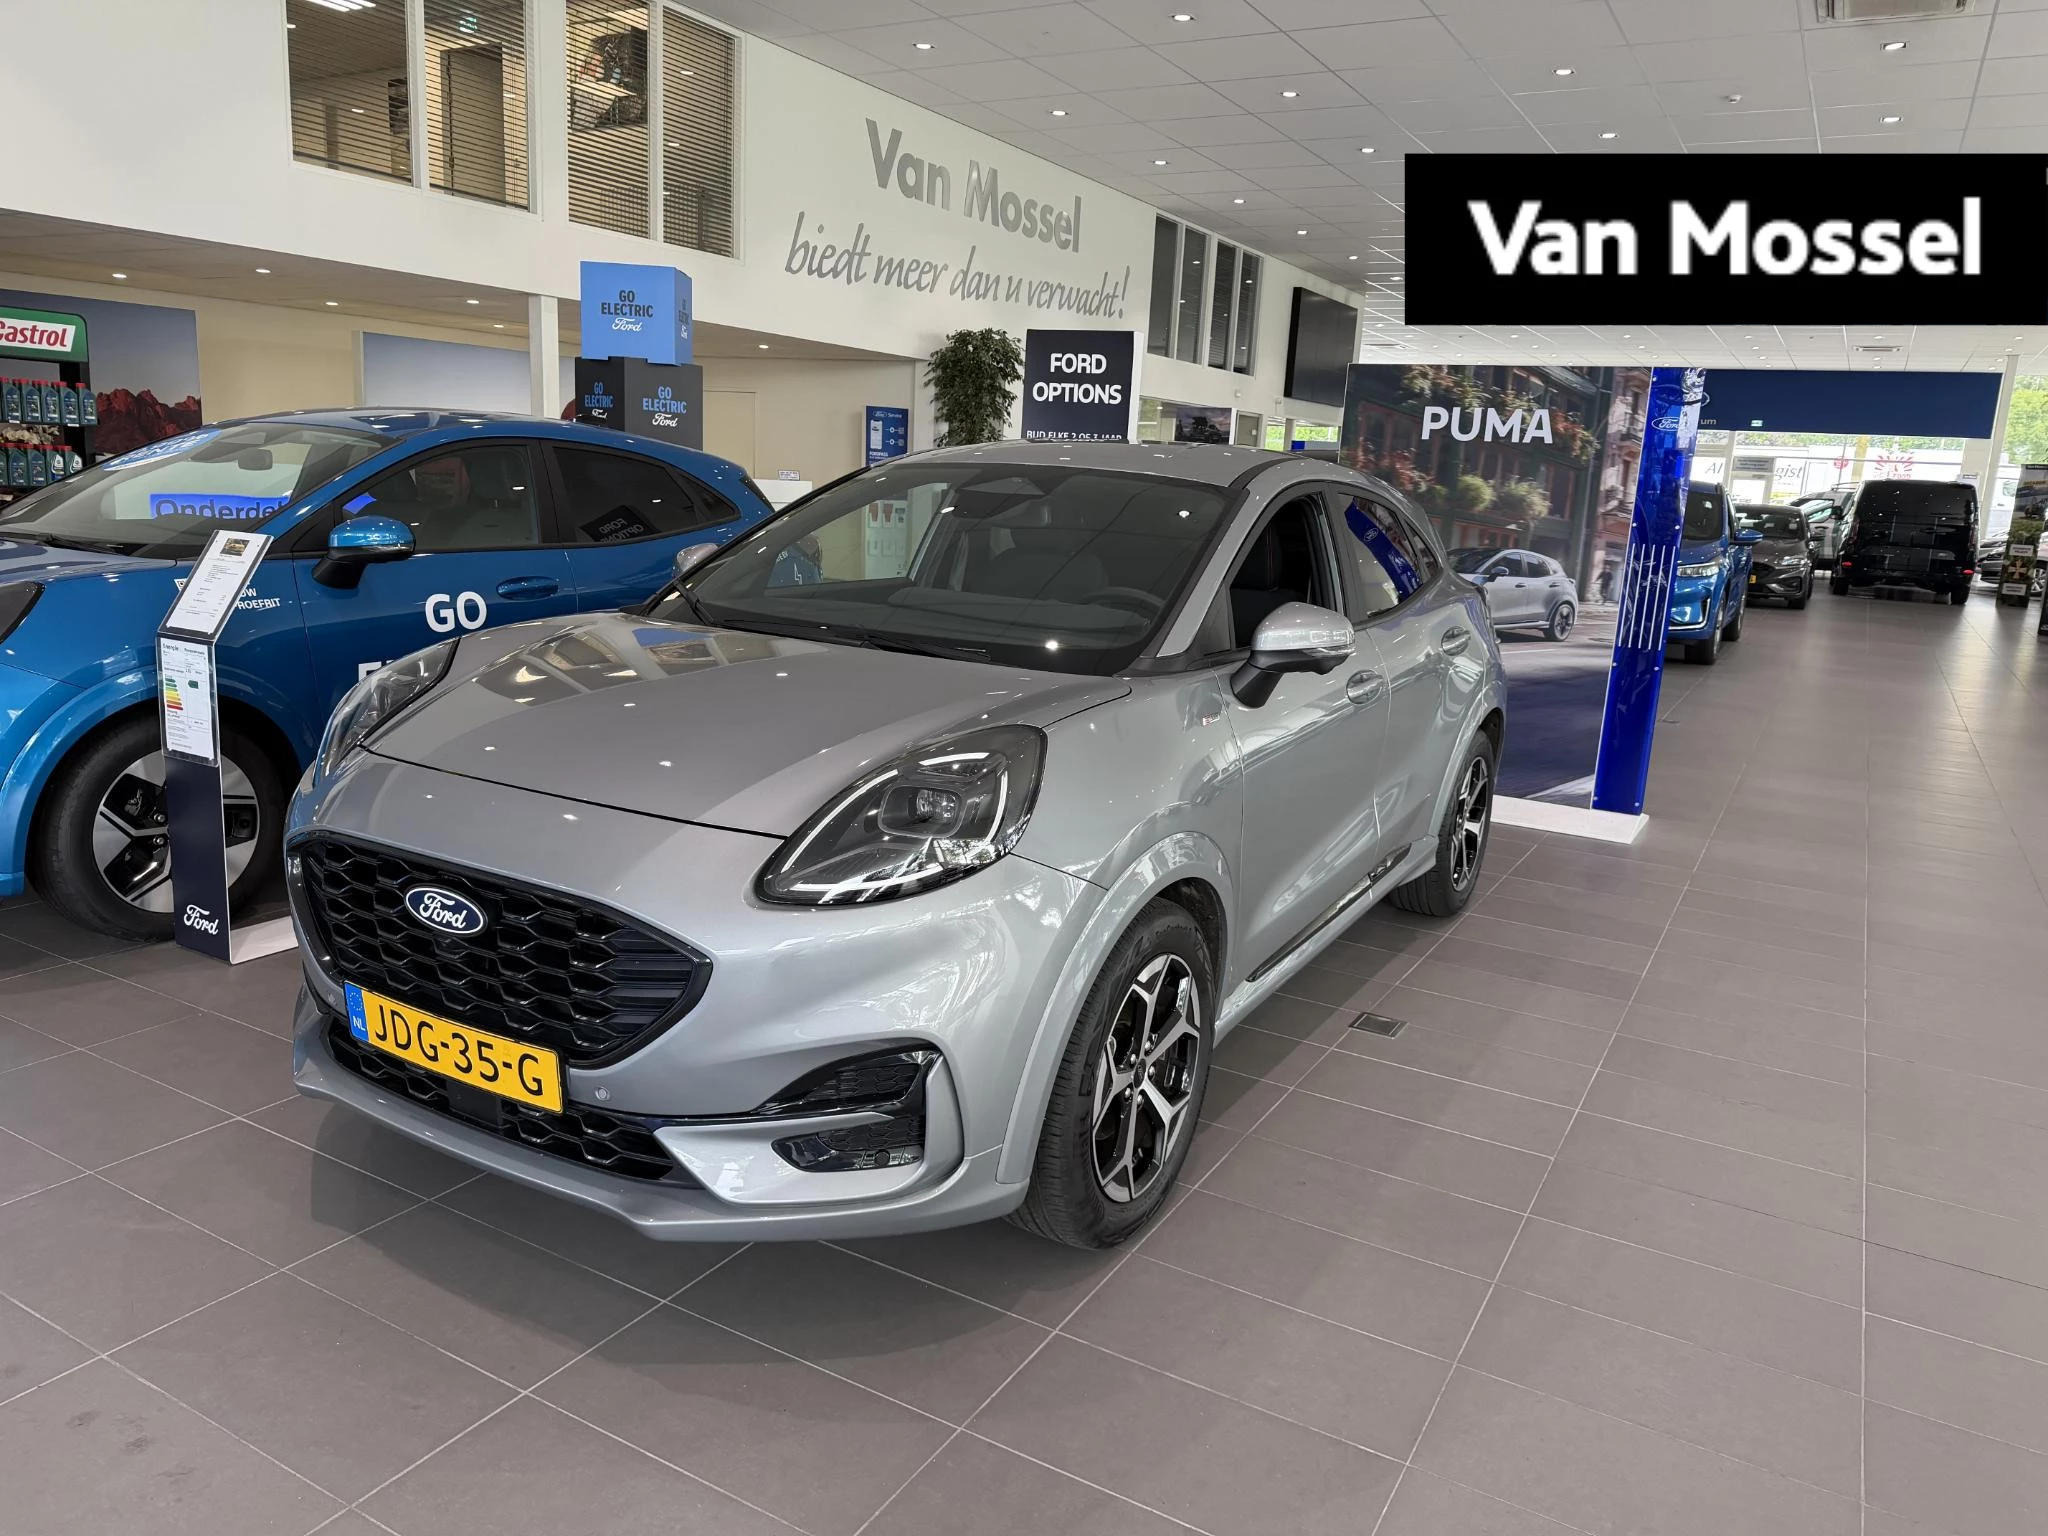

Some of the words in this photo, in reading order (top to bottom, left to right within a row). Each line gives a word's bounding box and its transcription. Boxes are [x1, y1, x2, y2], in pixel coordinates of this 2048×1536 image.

[865, 118, 951, 211] Van
[963, 159, 1082, 253] Mossel
[785, 210, 872, 286] biedt
[873, 254, 949, 294] meer
[949, 245, 999, 301] dan
[1006, 273, 1024, 304] u
[1027, 265, 1131, 319] verwacht!
[618, 290, 636, 303] GO
[601, 302, 654, 318] ELECTRIC
[611, 317, 642, 332] Ford
[1049, 353, 1107, 374] FORD
[593, 381, 604, 395] GO
[657, 386, 672, 400] GO
[1032, 381, 1122, 405] OPTIONS
[584, 394, 614, 408] ELECTRIC
[642, 398, 687, 414] ELECTRIC
[652, 412, 679, 428] Ford
[1420, 405, 1554, 444] PUMA
[424, 590, 488, 633] GO
[183, 904, 219, 935] Ford
[419, 892, 468, 929] Ford
[352, 1015, 366, 1032] NL
[375, 1003, 544, 1097] JDG-35-G
